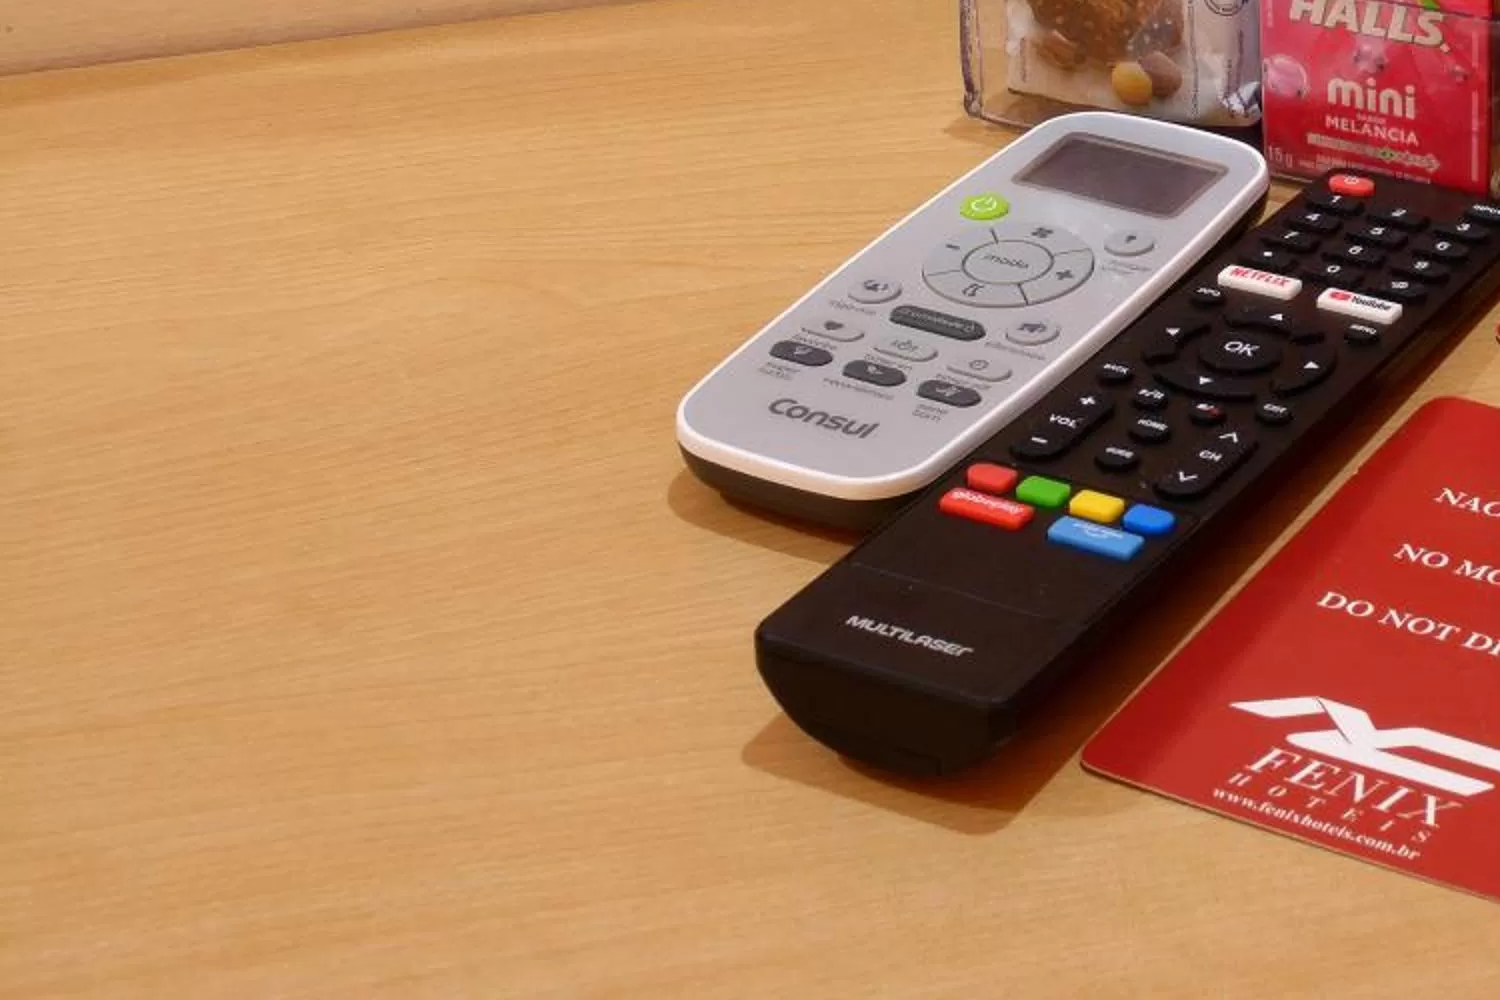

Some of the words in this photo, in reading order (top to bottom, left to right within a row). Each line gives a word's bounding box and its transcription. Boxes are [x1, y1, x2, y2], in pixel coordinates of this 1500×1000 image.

[1327, 76, 1416, 120] mini
[1325, 114, 1420, 147] MELANCIA
[1230, 266, 1290, 288] NETFLIX
[1223, 340, 1260, 358] OK
[768, 398, 880, 439] Consul
[1050, 413, 1080, 430] VOL
[1199, 449, 1224, 463] CH
[1393, 542, 1450, 570] NO
[1316, 590, 1376, 618] DO
[1378, 608, 1463, 643] NOT
[845, 614, 975, 659] MULTILASER
[1245, 746, 1464, 829] FENIX
[1213, 788, 1421, 862] www.fenixhoteis.com.br
